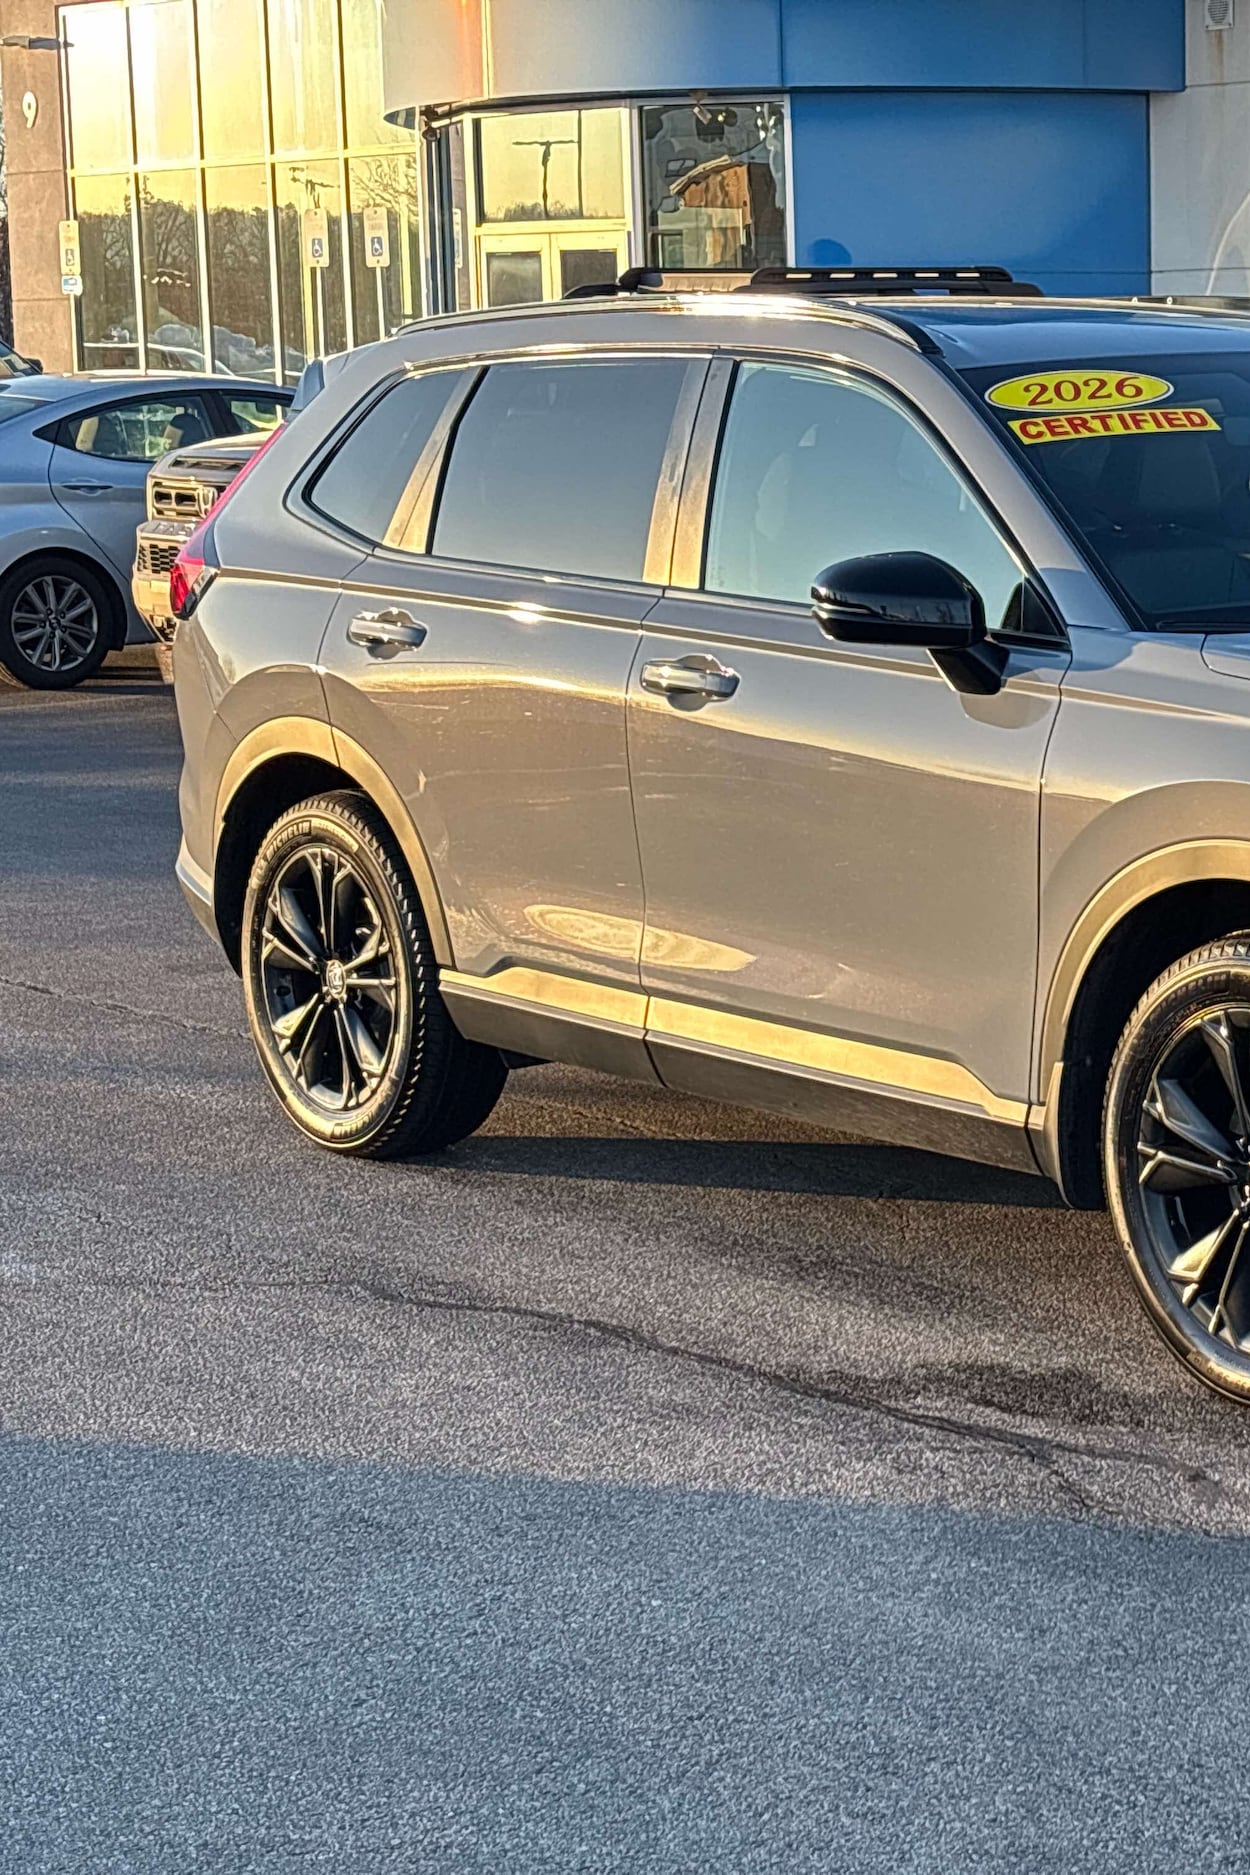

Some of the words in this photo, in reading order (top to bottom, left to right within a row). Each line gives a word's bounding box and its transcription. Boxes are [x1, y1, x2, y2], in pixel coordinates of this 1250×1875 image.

[22, 91, 37, 128] 9
[1023, 377, 1143, 406] 2026
[1018, 411, 1208, 439] CERTIFIED
